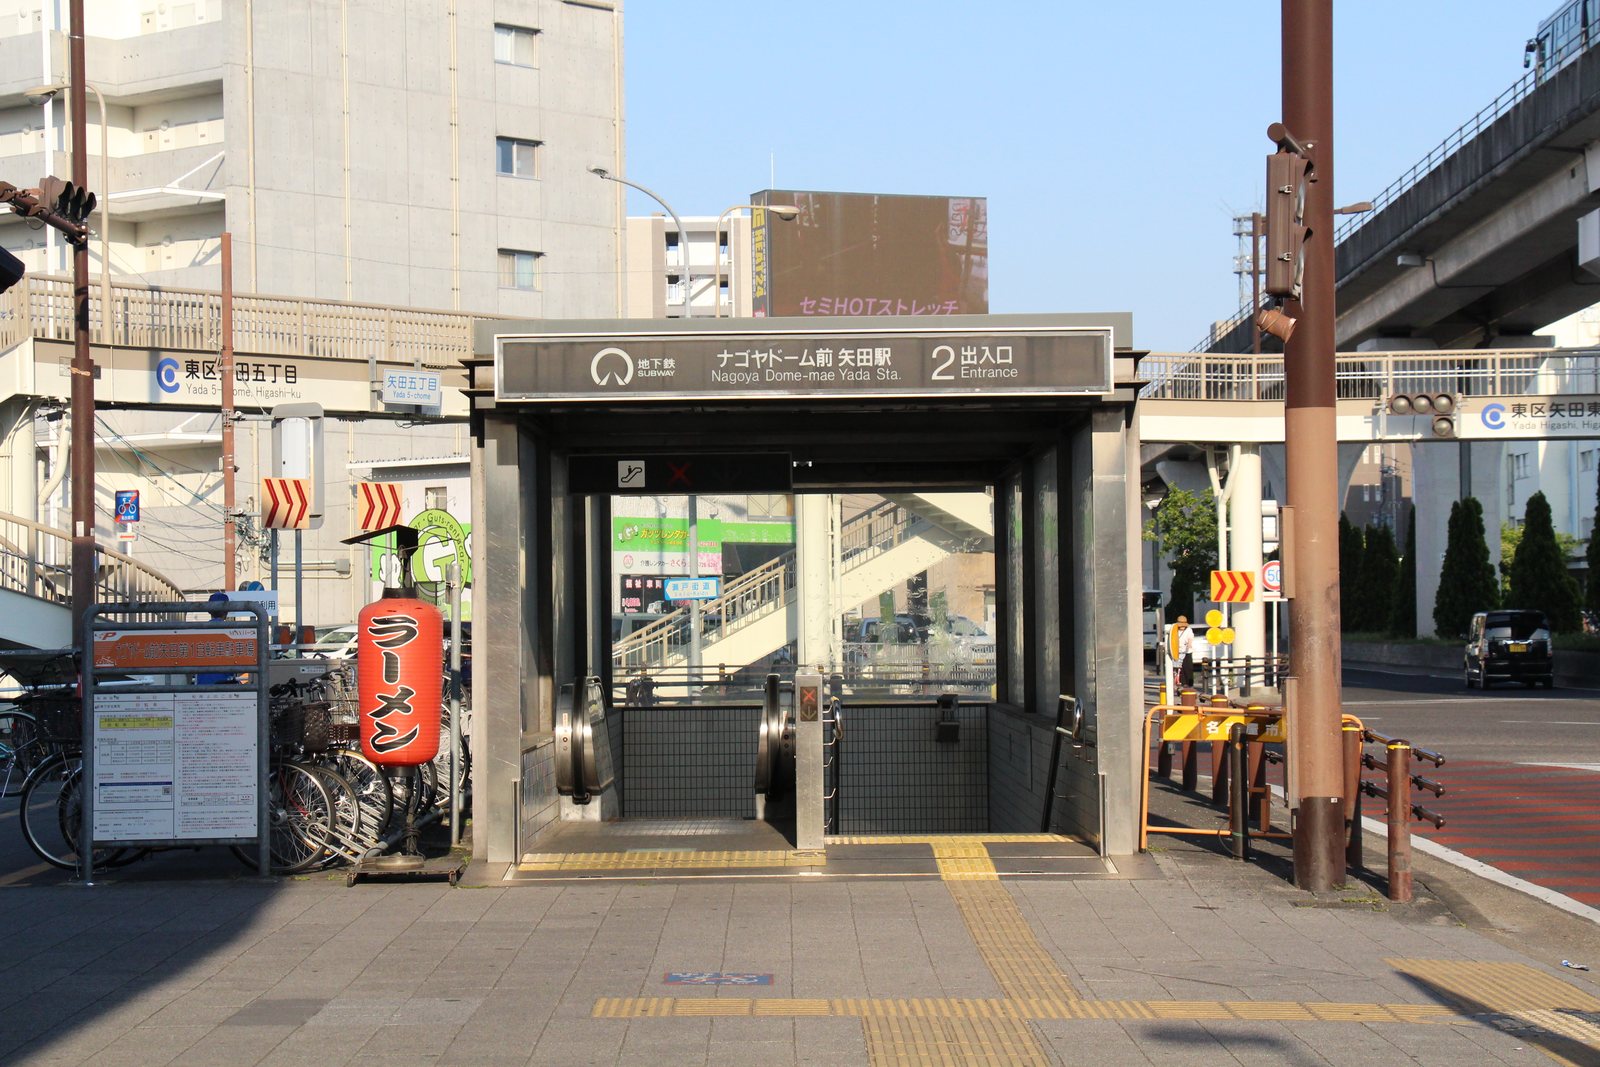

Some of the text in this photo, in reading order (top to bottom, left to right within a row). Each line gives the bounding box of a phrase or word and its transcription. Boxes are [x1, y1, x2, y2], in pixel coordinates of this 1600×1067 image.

[637, 358, 676, 370] 地下鉄
[716, 347, 892, 369] ナゴヤドーム前 矢田駅
[931, 345, 1013, 380] 2 出入口
[637, 369, 675, 377] SUBWAY
[711, 367, 902, 384] Nagoya Dome-mae Yada Sta.
[961, 366, 1018, 378] Entrance
[186, 383, 208, 395] Yada
[256, 386, 301, 399] Higashi-ku
[387, 375, 437, 391] 矢田五丁目
[392, 390, 406, 398] Yada
[1511, 402, 1600, 418] 東区矢田東
[1512, 421, 1536, 429] Yada
[1540, 420, 1578, 430] Higashi,
[367, 614, 420, 755] ラーメン
